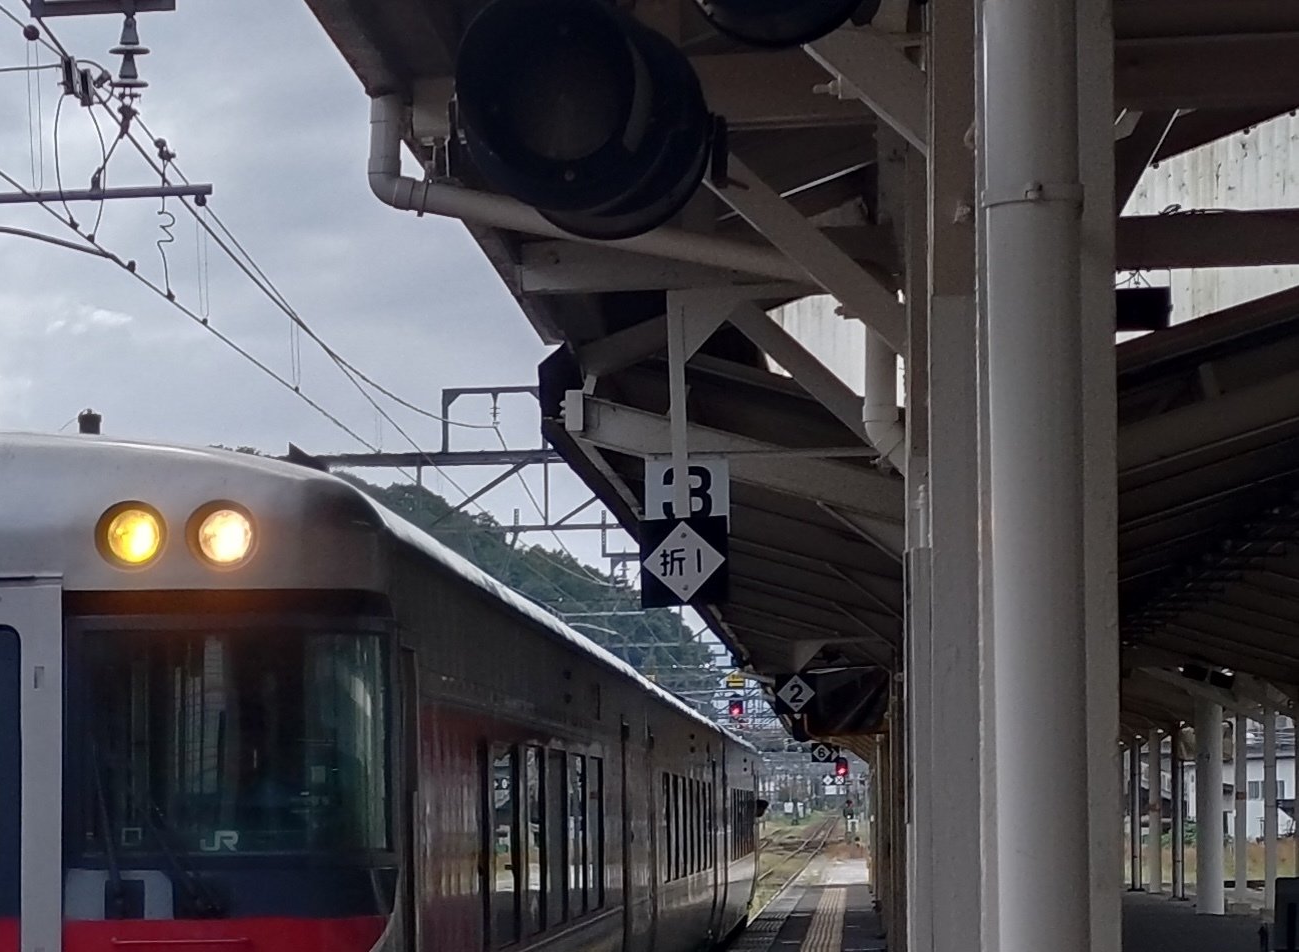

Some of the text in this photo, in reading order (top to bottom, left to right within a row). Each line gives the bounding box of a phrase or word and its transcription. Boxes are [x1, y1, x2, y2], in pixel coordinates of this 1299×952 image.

[789, 683, 804, 703] 2
[817, 747, 826, 758] 6
[200, 830, 238, 851] JR
